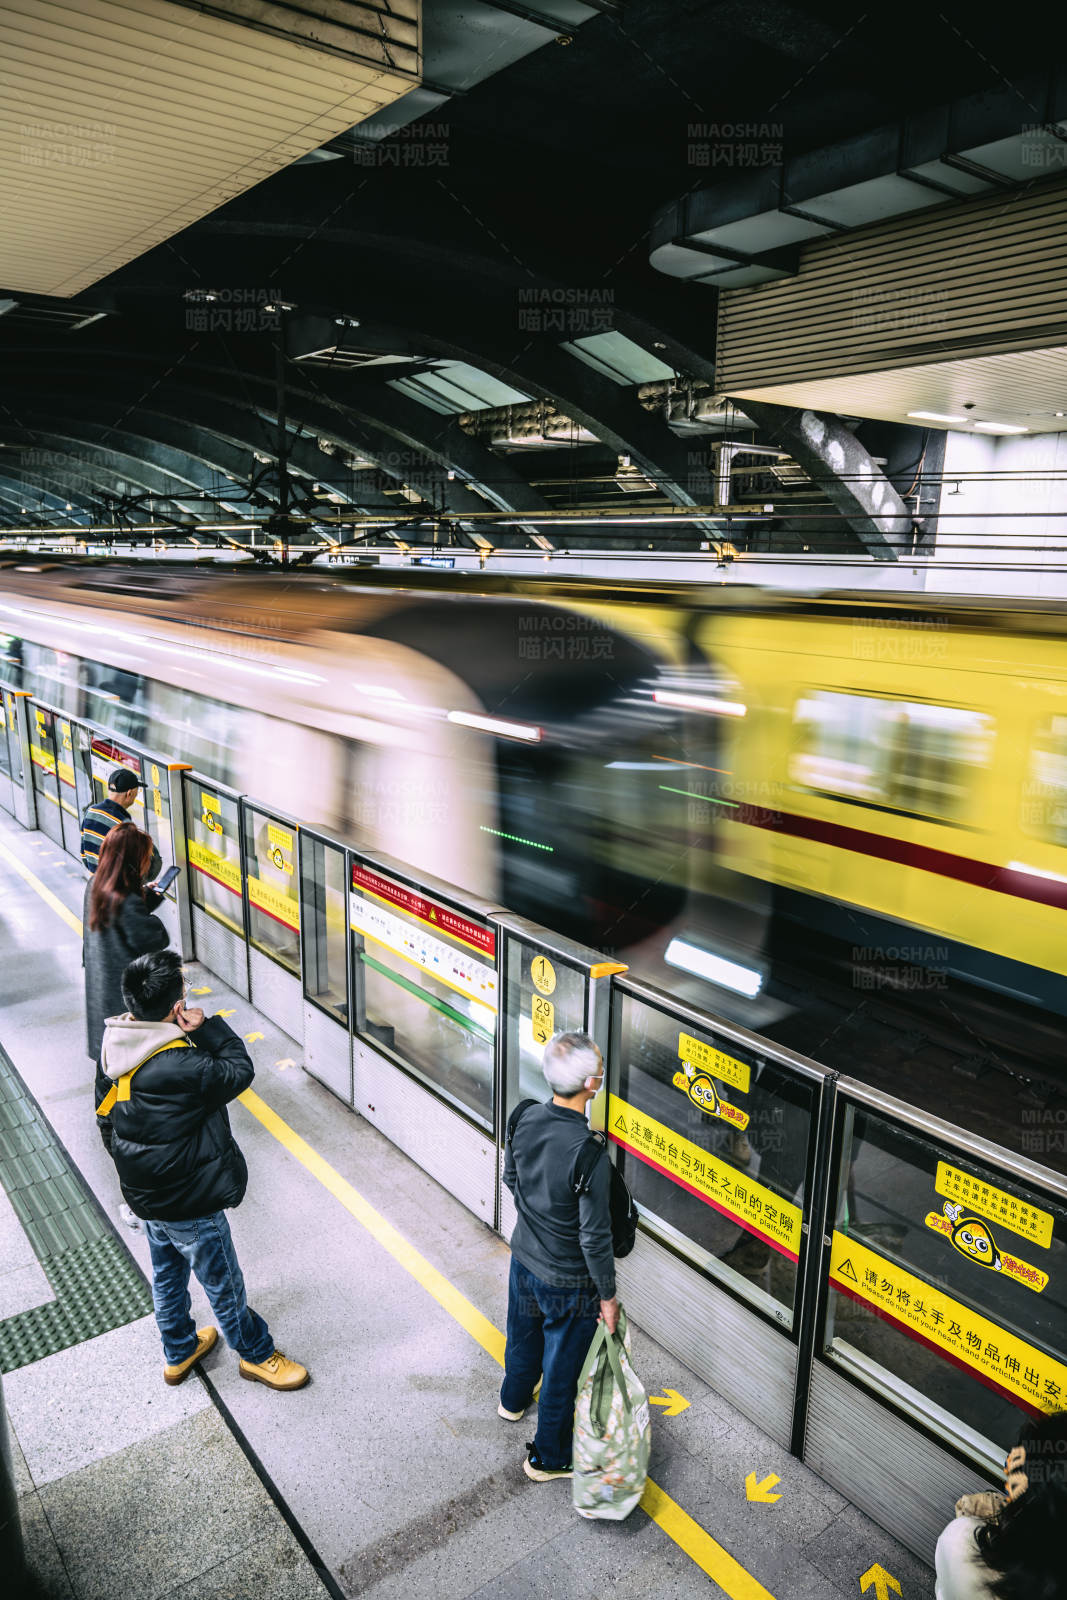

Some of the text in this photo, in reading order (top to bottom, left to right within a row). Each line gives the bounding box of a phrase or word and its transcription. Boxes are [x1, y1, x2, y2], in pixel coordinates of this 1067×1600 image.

[536, 998, 551, 1017] 29
[539, 958, 546, 977] 1
[630, 1118, 795, 1234] 注意站台与列车之间的空隙
[630, 1133, 792, 1244] Please mind the gap between train and platform.
[929, 1215, 954, 1236] 文明
[861, 1281, 885, 1301] Please
[885, 1296, 895, 1307] do
[895, 1303, 907, 1315] not
[907, 1312, 919, 1323] put
[920, 1319, 937, 1334] your
[960, 1343, 980, 1360] hand
[980, 1356, 990, 1366] or
[990, 1363, 1021, 1386] articles
[864, 1267, 1067, 1407] 请勿将头手及物品伸出安
